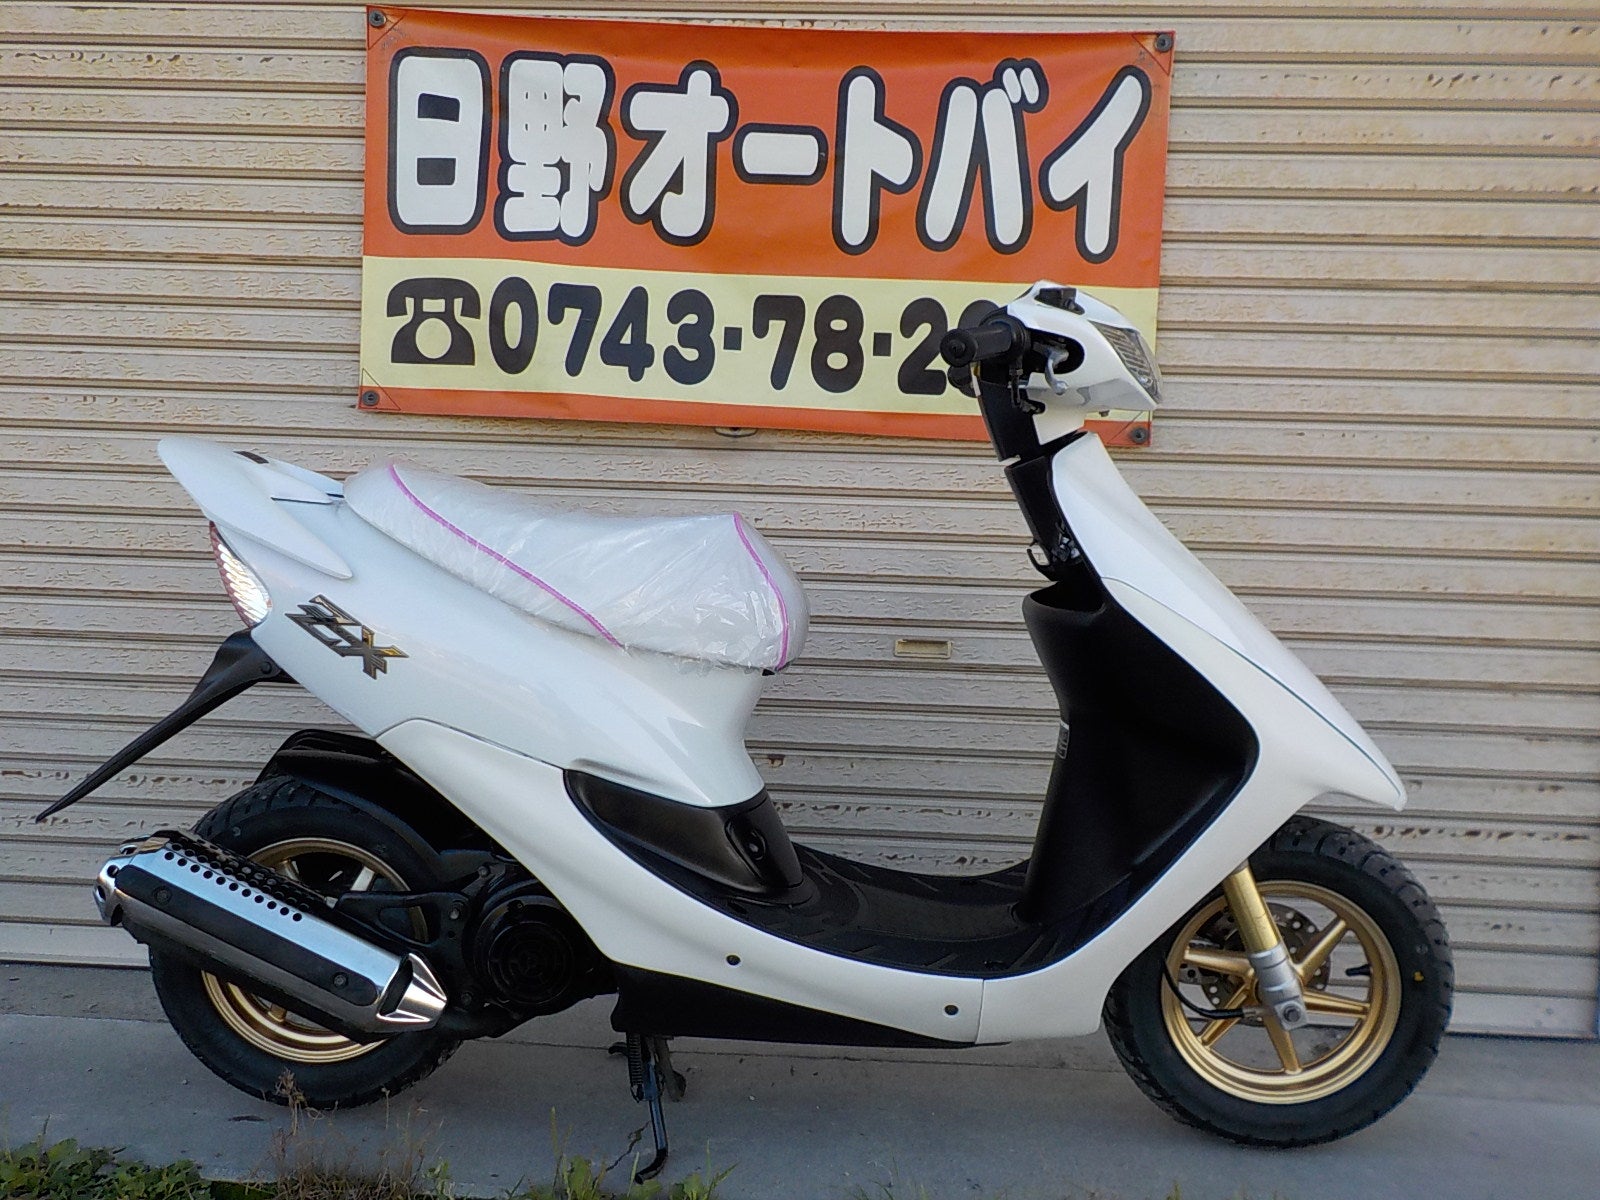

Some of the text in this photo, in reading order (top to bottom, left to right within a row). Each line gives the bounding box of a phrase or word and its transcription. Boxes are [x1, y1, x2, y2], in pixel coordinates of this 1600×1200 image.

[389, 48, 1147, 263] 日野オートバイ
